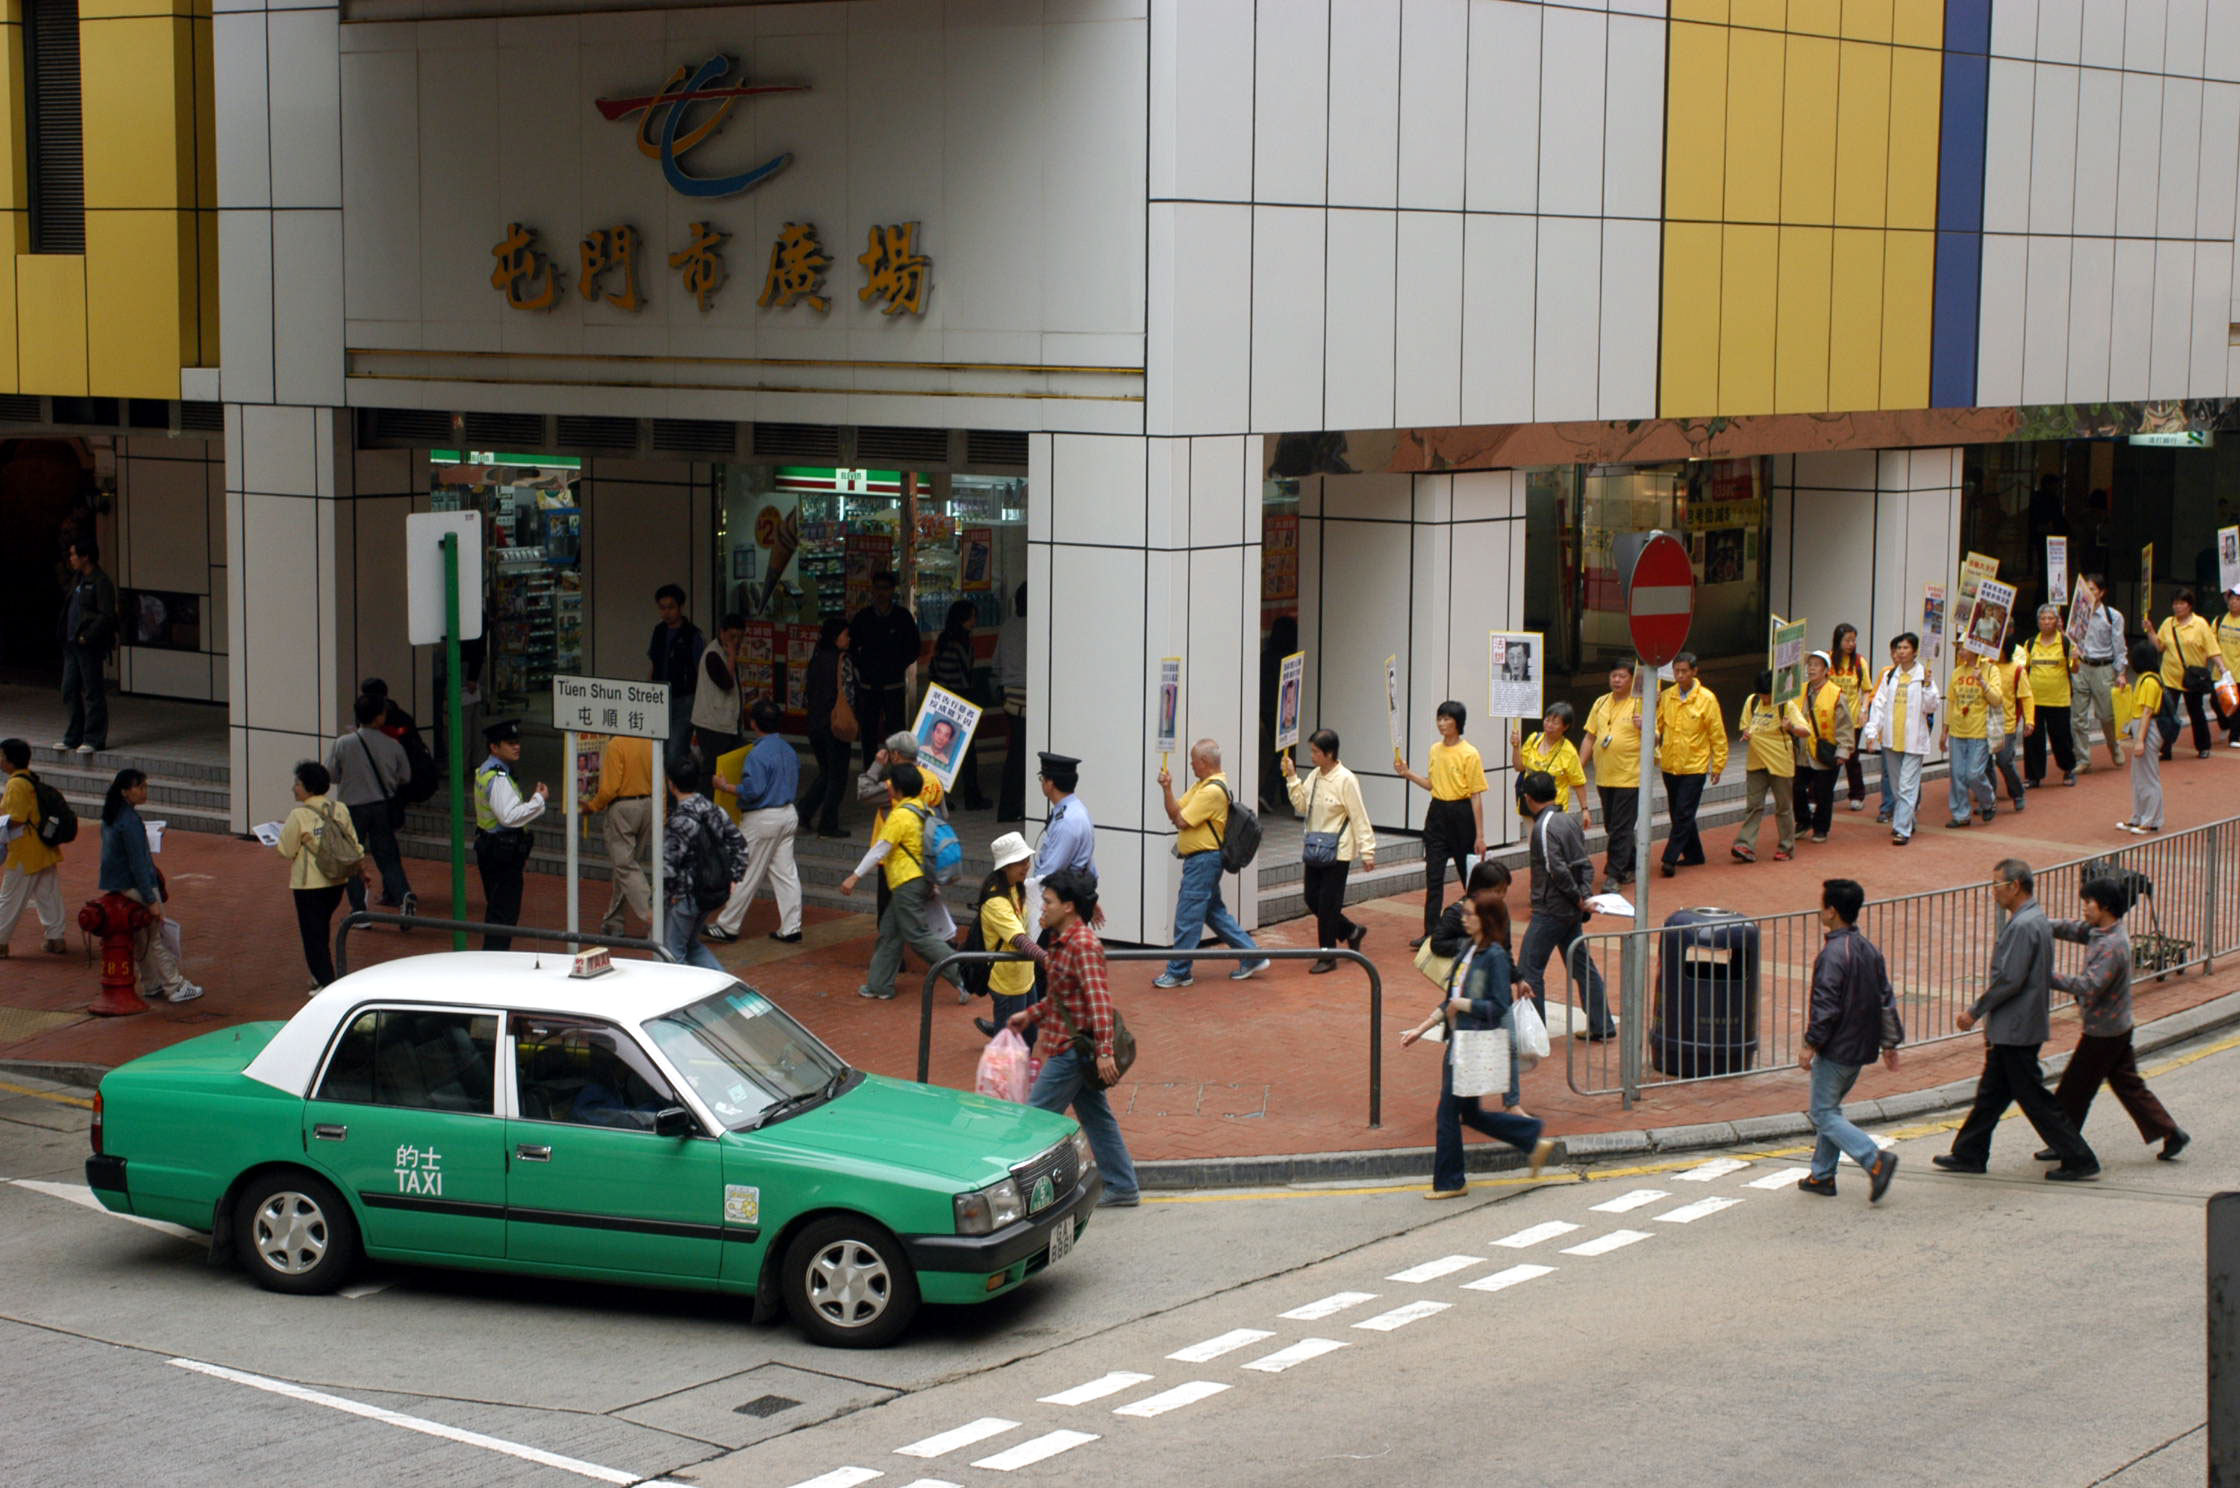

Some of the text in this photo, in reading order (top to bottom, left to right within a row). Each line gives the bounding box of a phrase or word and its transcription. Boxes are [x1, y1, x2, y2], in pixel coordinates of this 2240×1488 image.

[490, 222, 930, 315] 屯門市廣場
[558, 680, 664, 704] Tuen Shun Street
[578, 706, 644, 731] 屯順街
[396, 1144, 442, 1170] 的士
[394, 1168, 442, 1196] TAXI
